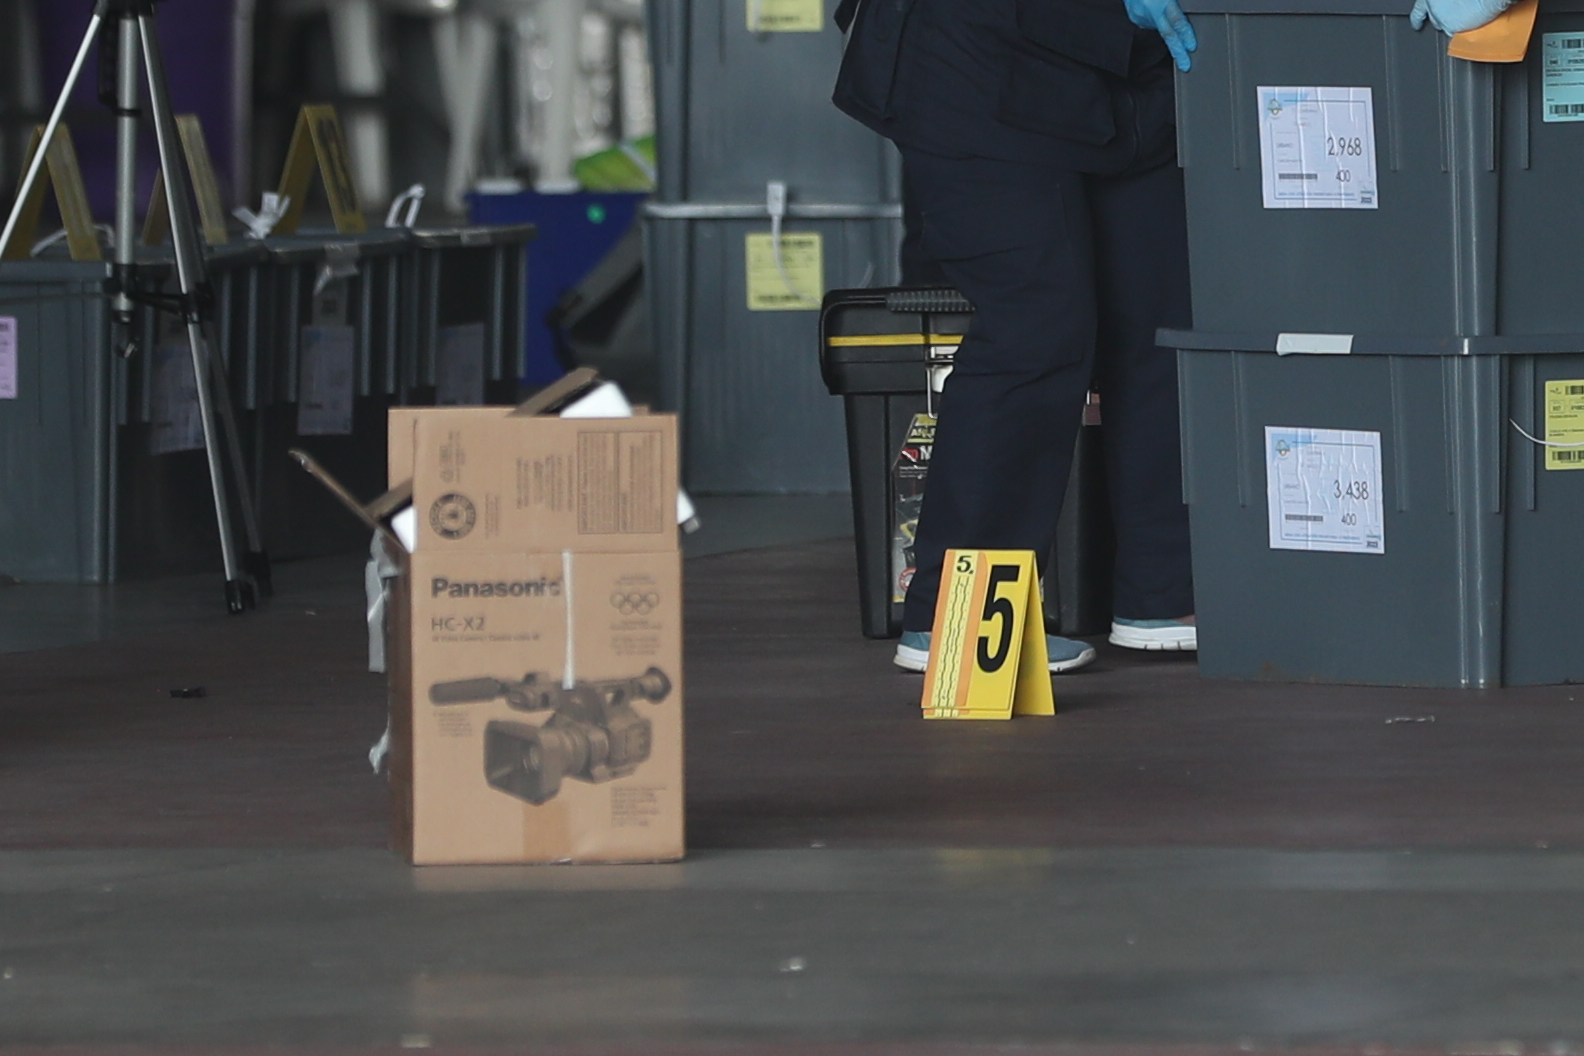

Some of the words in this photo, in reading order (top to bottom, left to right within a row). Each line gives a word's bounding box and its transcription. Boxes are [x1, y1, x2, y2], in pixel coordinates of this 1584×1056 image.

[1327, 137, 1362, 157] 2,968
[1336, 169, 1351, 183] 400
[1333, 479, 1369, 501] 3,438
[1341, 513, 1357, 526] 400
[431, 576, 561, 599] Panasonic
[430, 616, 485, 632] HC-X2
[976, 564, 1021, 674] 5
